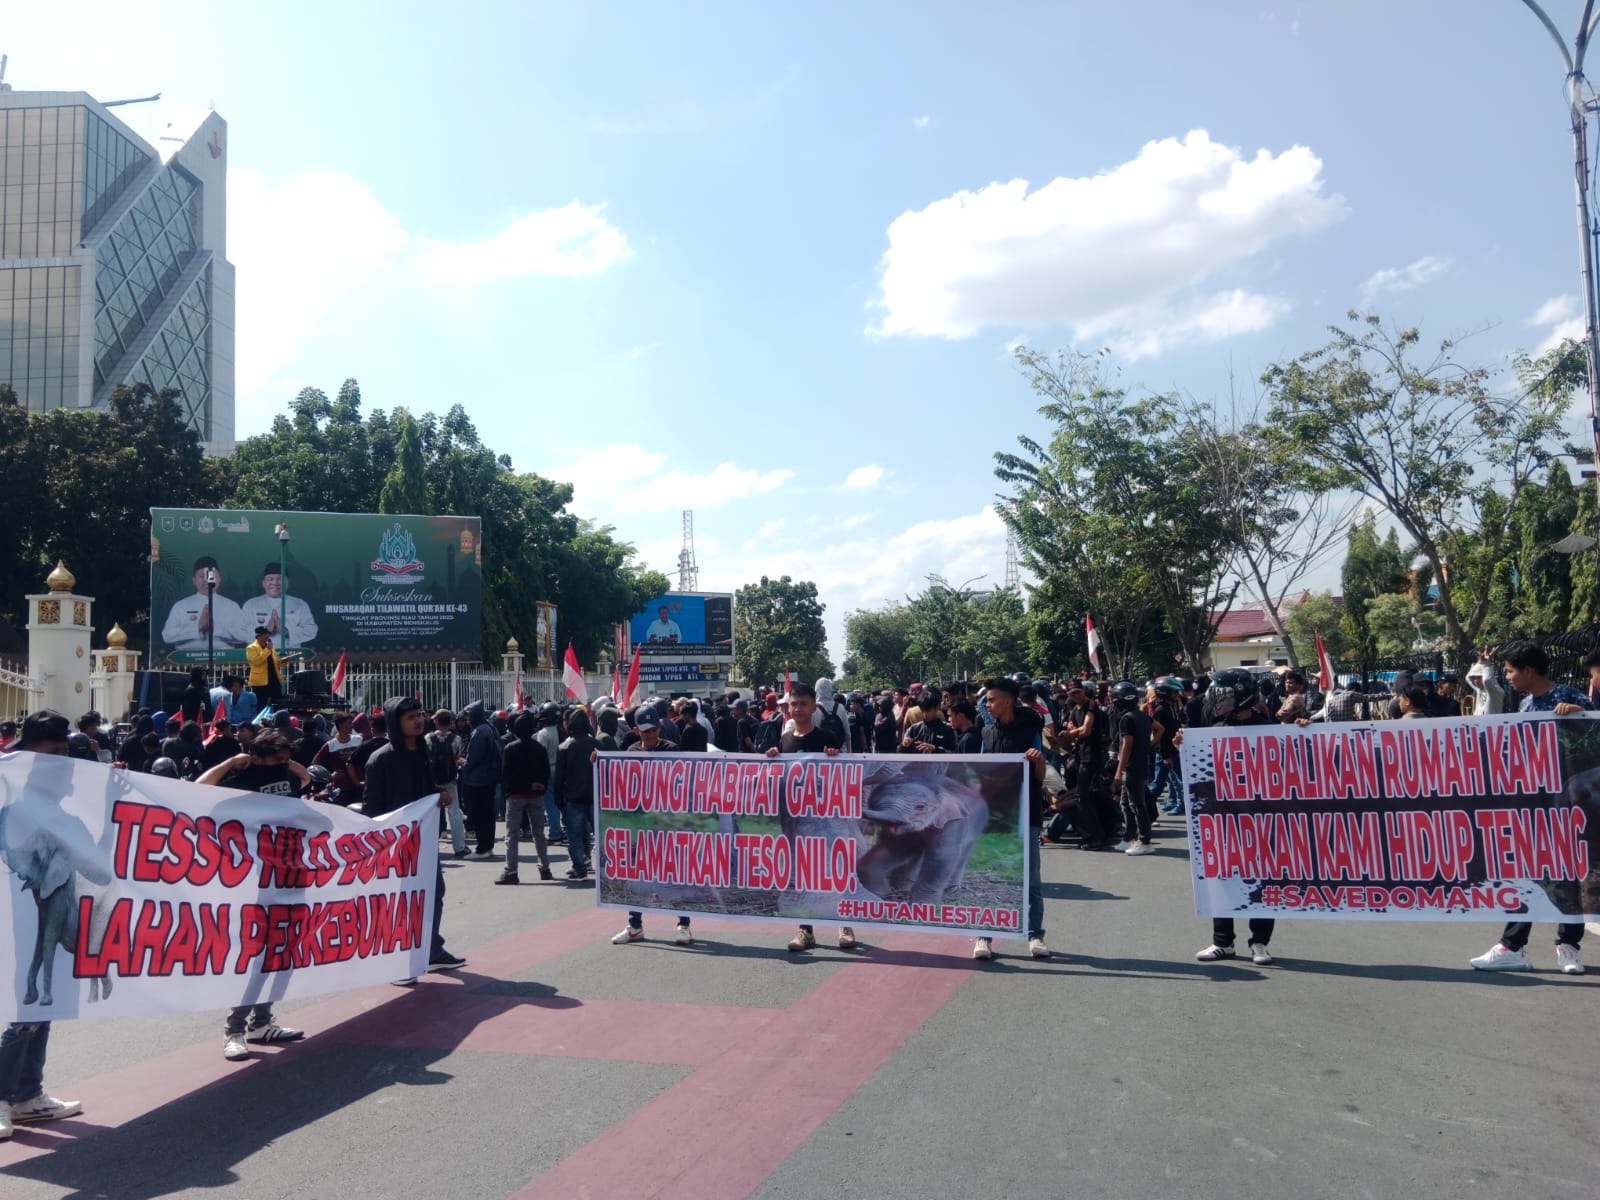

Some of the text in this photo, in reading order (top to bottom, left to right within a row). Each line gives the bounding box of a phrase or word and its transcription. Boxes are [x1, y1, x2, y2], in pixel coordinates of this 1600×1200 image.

[325, 604, 468, 614] MUSABAQAH TILAWATIL QUR'AN KE-43
[599, 757, 864, 819] LINDUNGI HABITAT GAJAH
[1212, 721, 1563, 801] KEMBALIKAN RUMAH KAMI
[111, 800, 422, 888] TESSO NILO BUKAN
[604, 827, 857, 894] SELAMATKAN TESO NILO!
[1198, 805, 1589, 882] BIARKAN KAMI HIDUP TENANG
[837, 900, 1020, 928] #HUTANLESTARI
[1261, 884, 1523, 910] #SAVEDOMANG
[73, 889, 426, 979] LAHAN PERKEBUNAN
